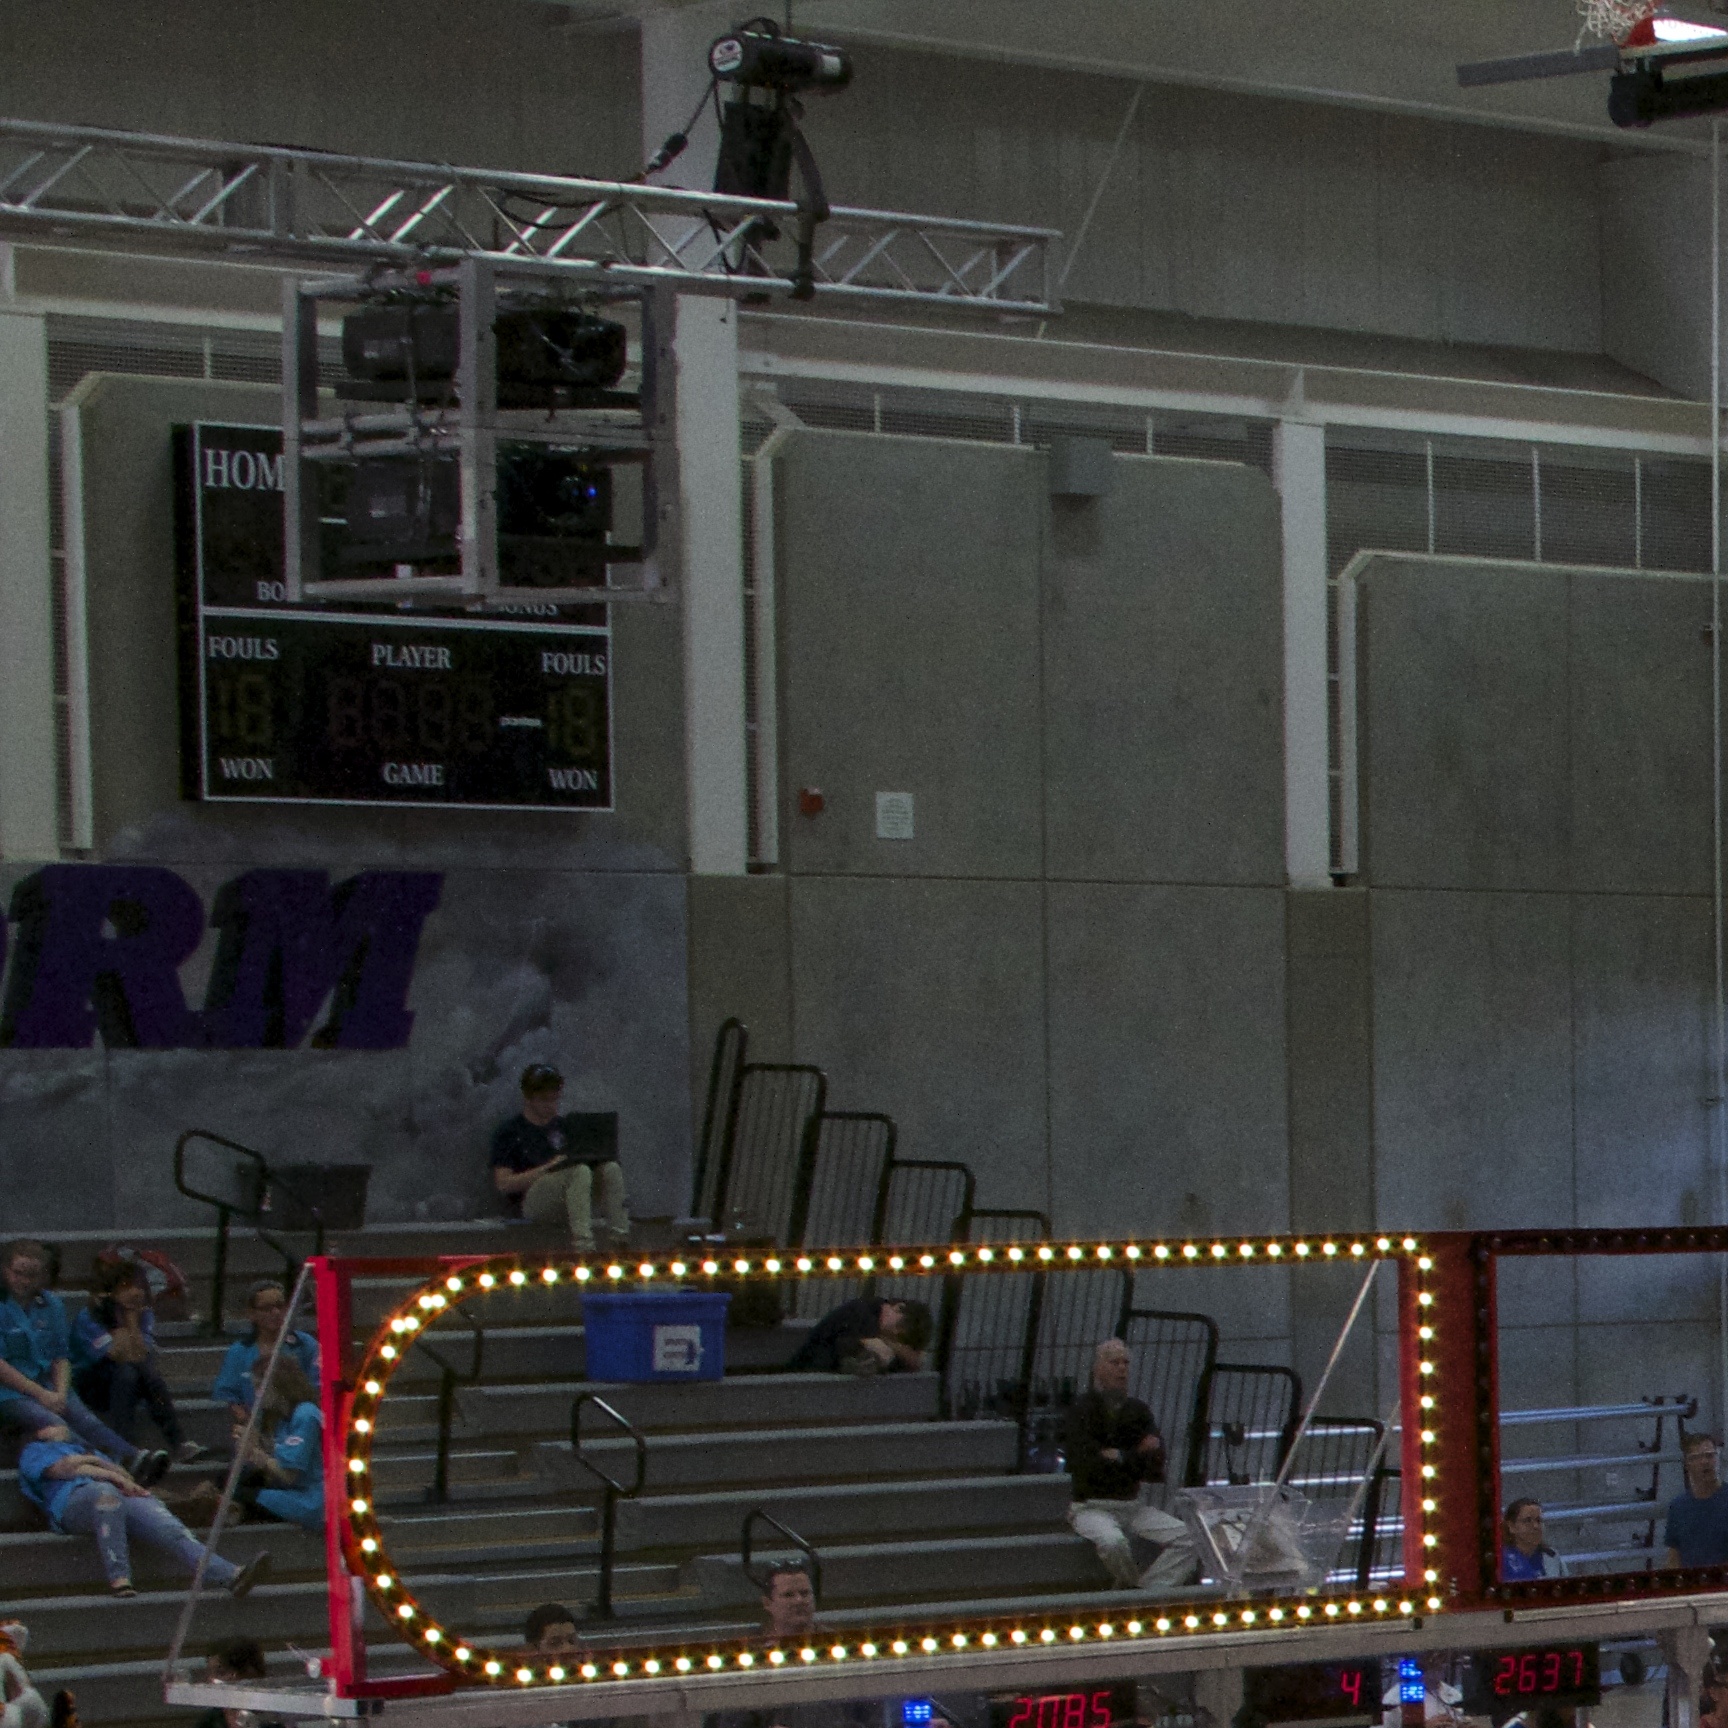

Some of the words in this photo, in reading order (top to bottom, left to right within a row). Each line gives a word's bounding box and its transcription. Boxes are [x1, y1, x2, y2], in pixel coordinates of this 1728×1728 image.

[204, 447, 286, 491] HOM
[208, 636, 279, 661] FOULS
[371, 644, 451, 670] PLAYER
[541, 652, 606, 677] FOULS
[219, 757, 273, 781] WON
[382, 762, 446, 787] GAME
[548, 768, 598, 791] WON
[0, 864, 445, 1049] RM
[1339, 1670, 1362, 1706] 4
[1493, 1651, 1584, 1696] 2637
